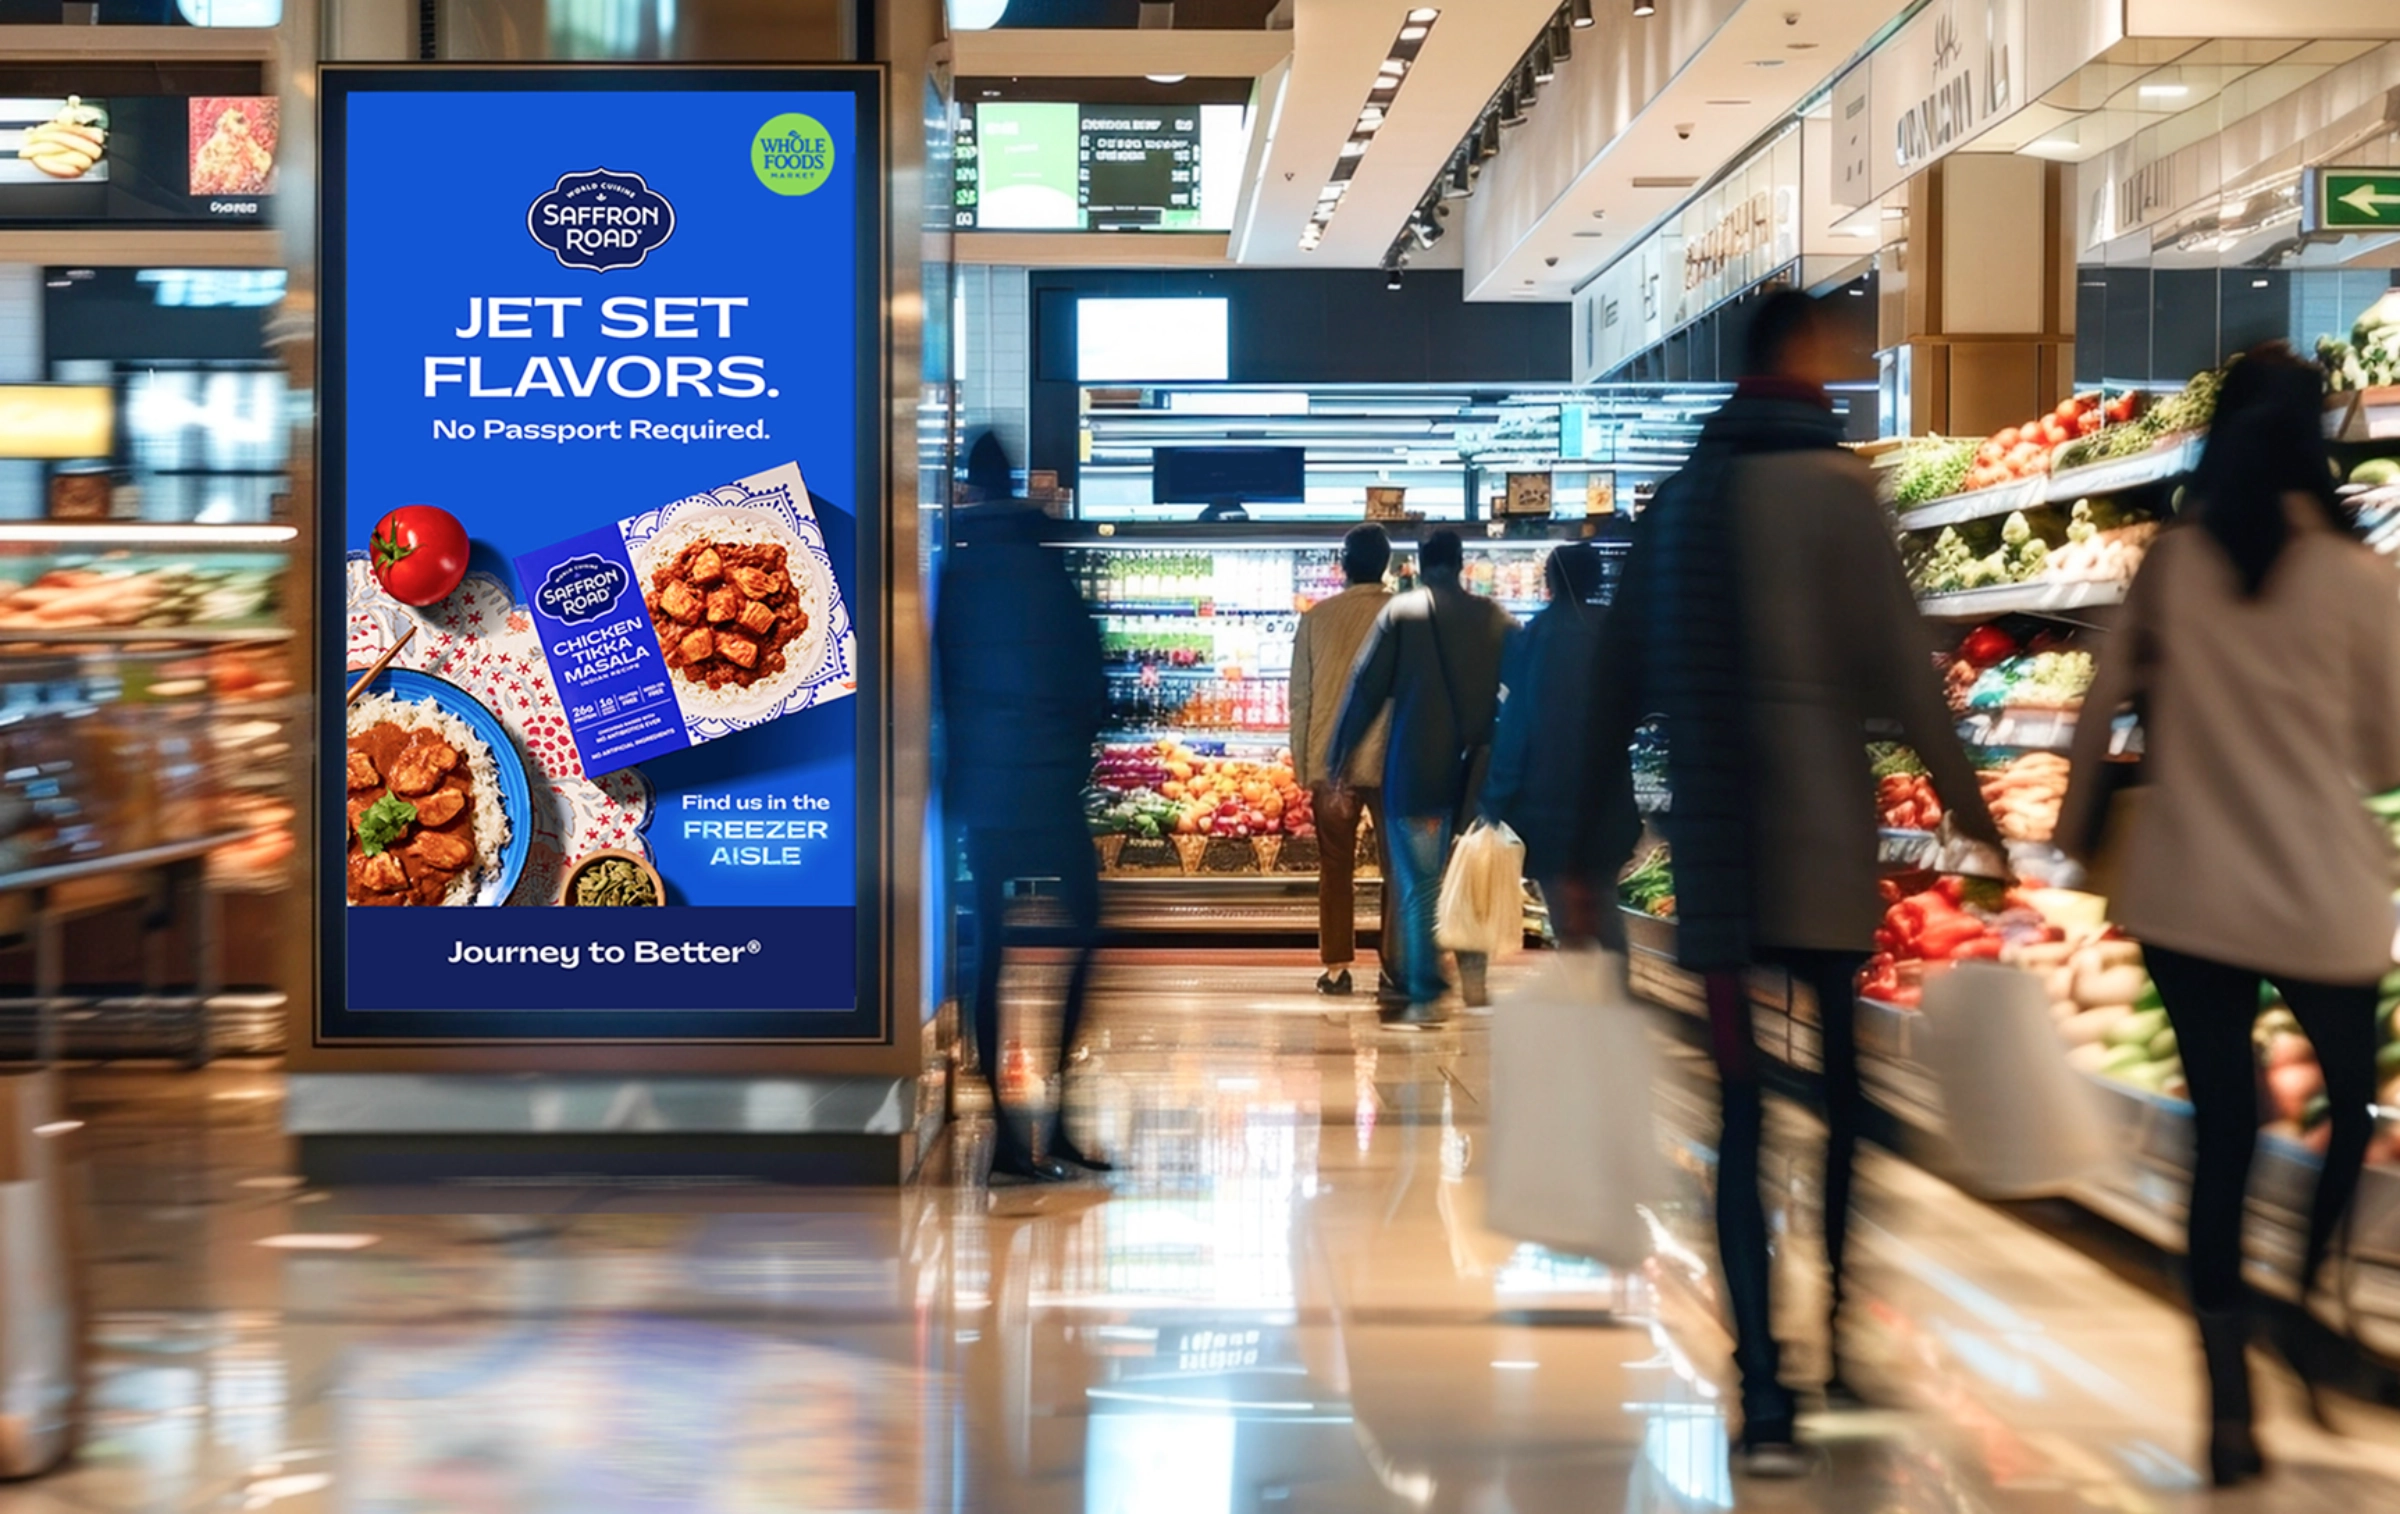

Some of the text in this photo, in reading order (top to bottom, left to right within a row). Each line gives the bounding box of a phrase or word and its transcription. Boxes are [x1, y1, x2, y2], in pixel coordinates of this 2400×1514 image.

[760, 135, 826, 154] WHOLE
[764, 154, 825, 170] FOODS
[566, 182, 636, 199] WORLD CUISINE
[543, 203, 659, 226] SAFFRON
[566, 228, 638, 256] ROAD
[455, 296, 749, 339] JET SET
[424, 355, 780, 399] FLAVORS.
[432, 419, 771, 444] No Passport Required.
[543, 569, 619, 605] SAFFRON
[562, 588, 610, 615] ROAD
[552, 616, 643, 656] CHICKEN
[571, 636, 633, 664] TIKKA
[564, 645, 651, 684] MASALA
[682, 794, 830, 810] Find us in the
[683, 820, 829, 840] FREEZER
[709, 846, 802, 866] AISLE
[448, 940, 580, 969] Journey
[588, 941, 625, 963] to
